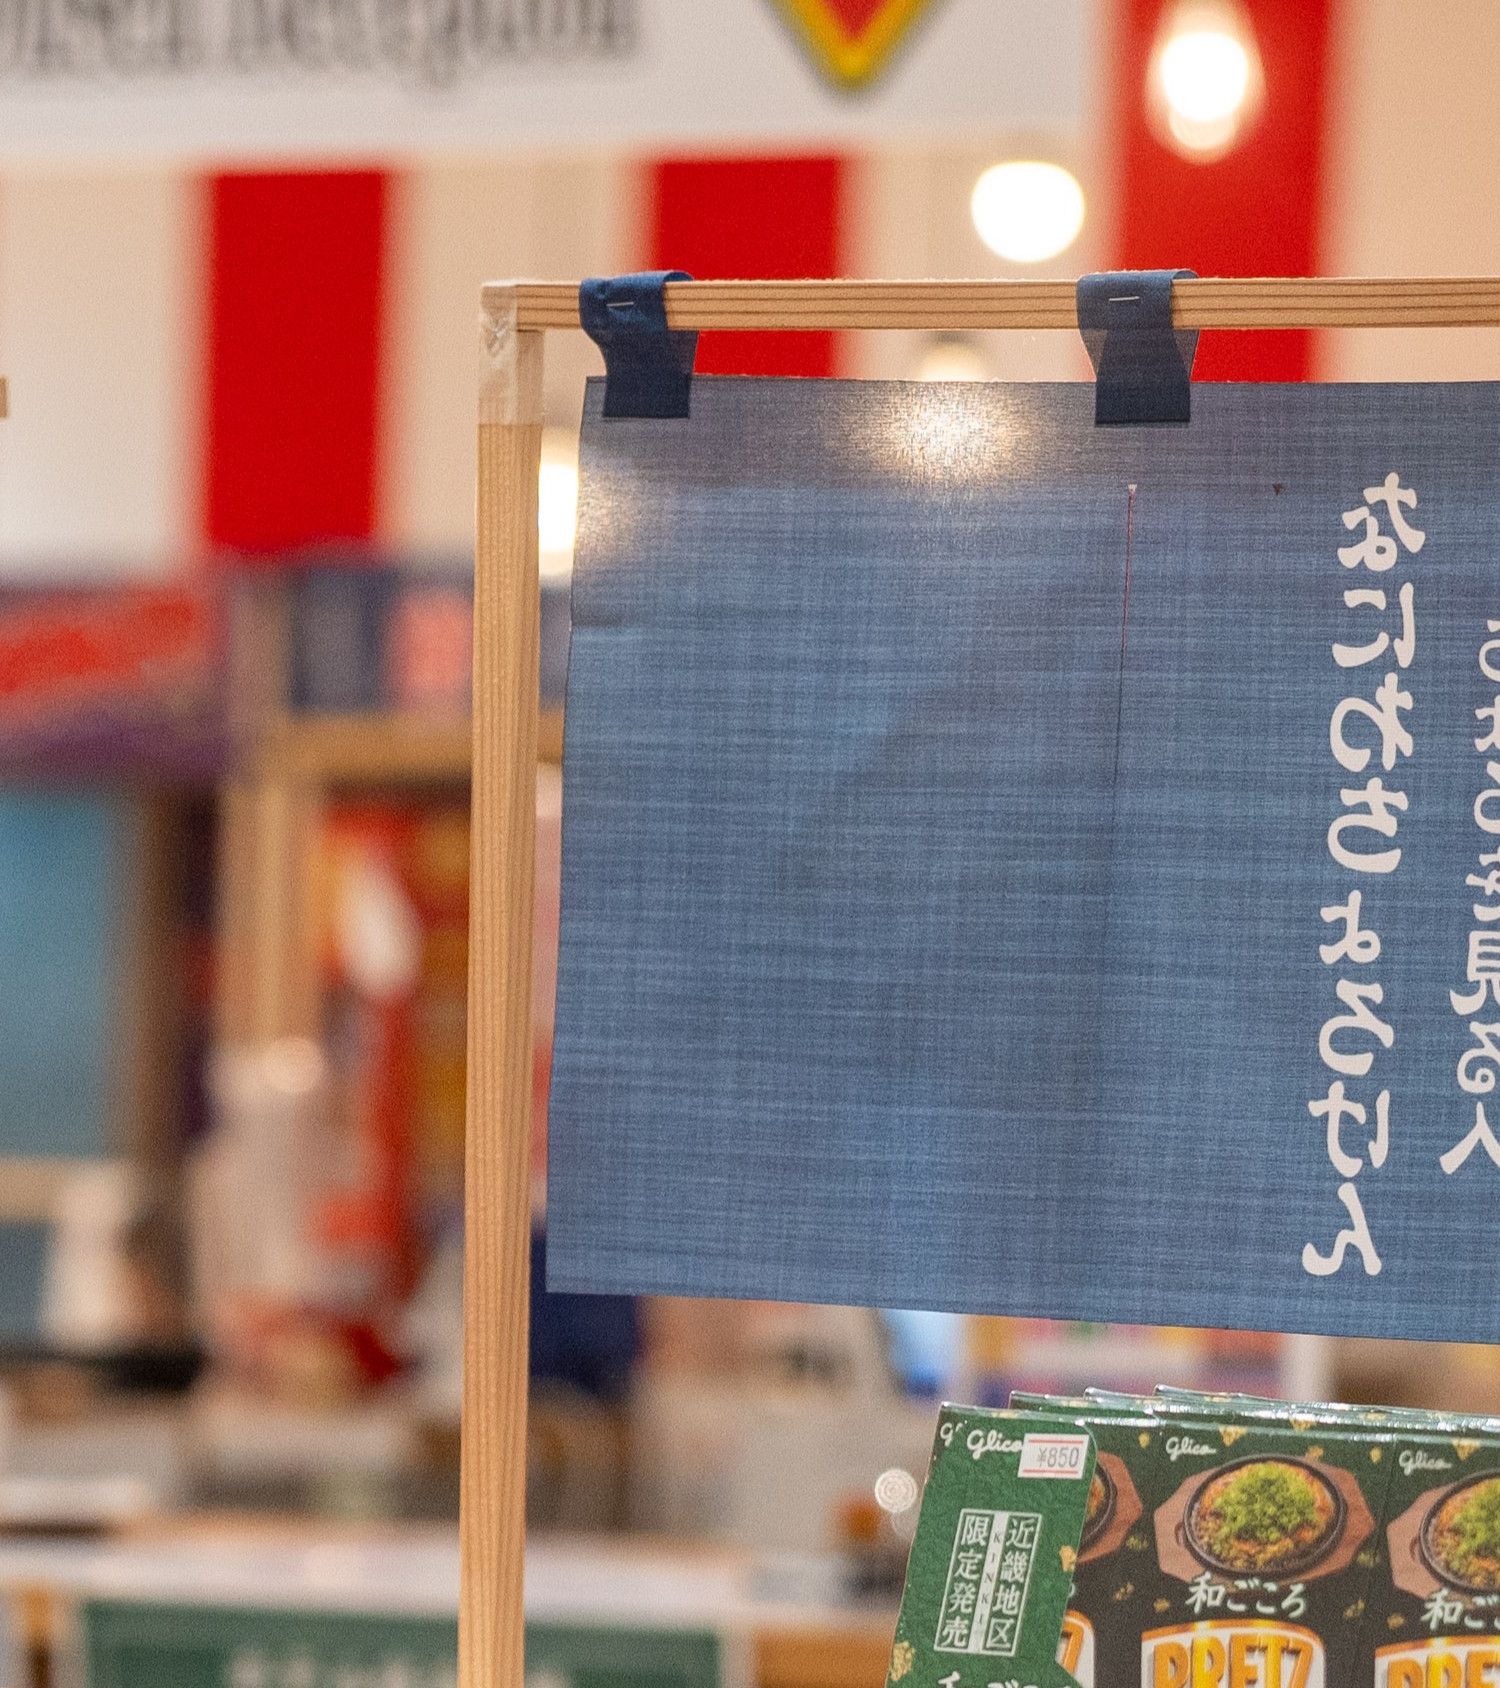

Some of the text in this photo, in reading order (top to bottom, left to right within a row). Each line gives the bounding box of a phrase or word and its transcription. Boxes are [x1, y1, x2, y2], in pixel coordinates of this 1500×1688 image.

[1037, 1447, 1079, 1468] ¥850
[939, 1514, 989, 1649] 限定発売
[986, 1516, 1036, 1653] 近畿地区
[1187, 1572, 1306, 1618] 和ごころ
